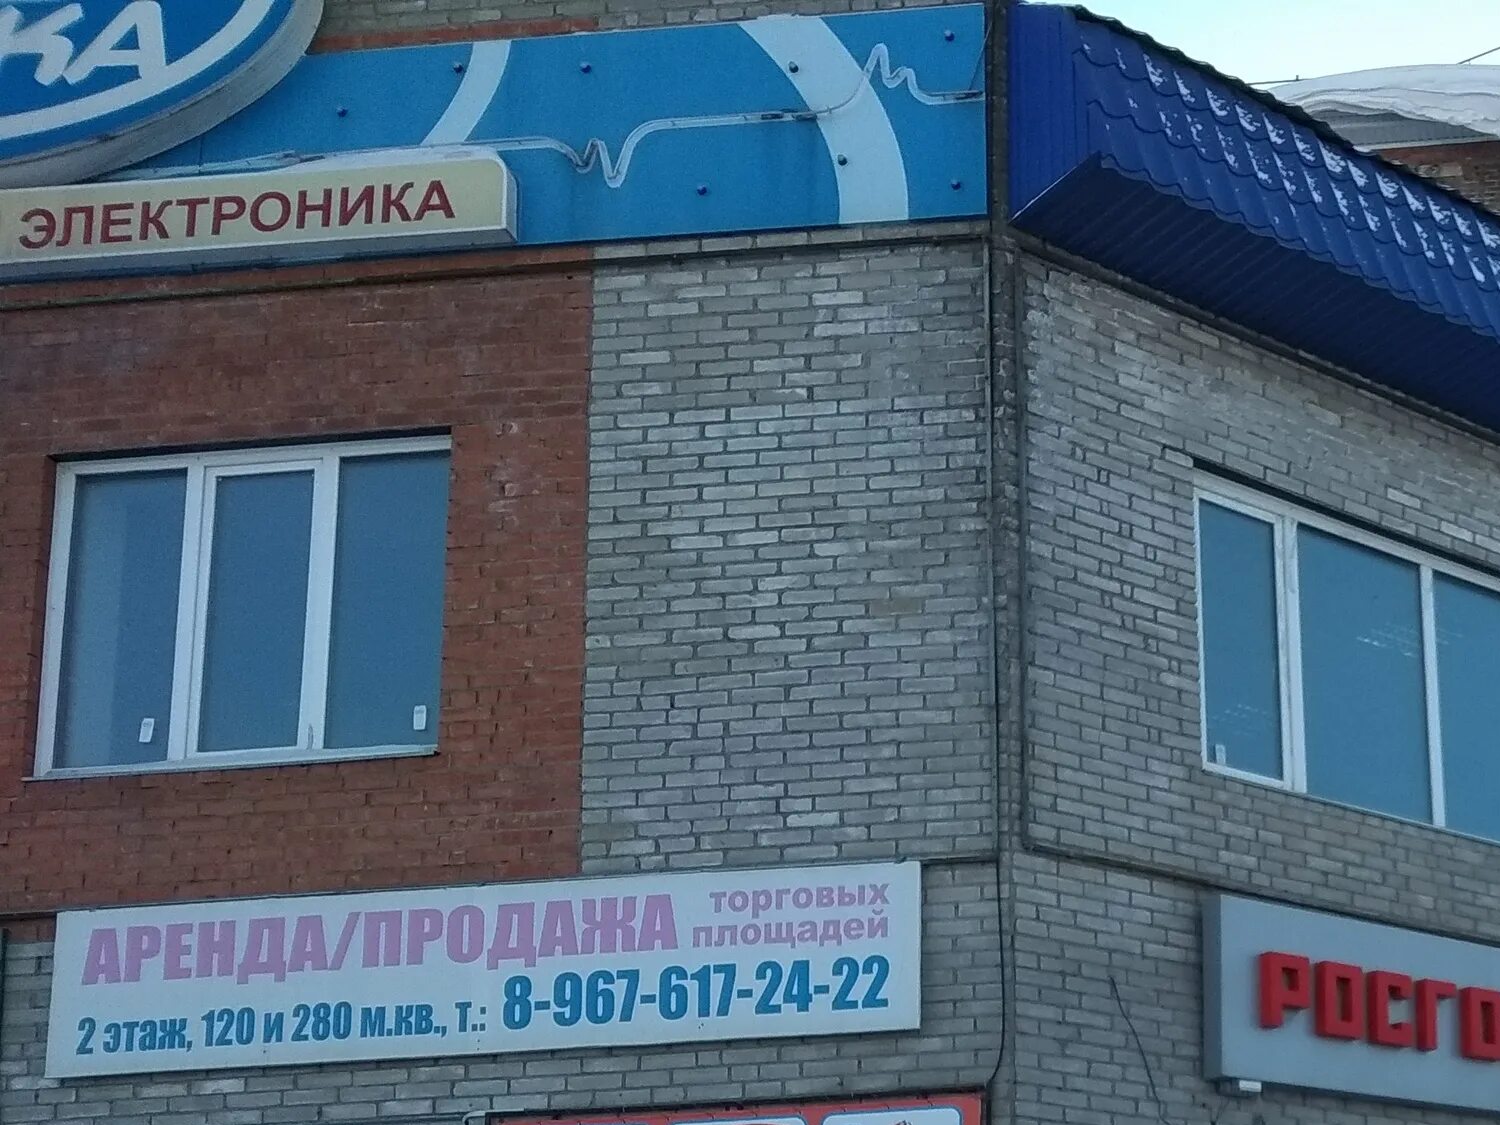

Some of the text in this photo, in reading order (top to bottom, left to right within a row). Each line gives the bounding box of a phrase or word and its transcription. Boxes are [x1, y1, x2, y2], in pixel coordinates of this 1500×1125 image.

[19, 180, 456, 250] ЭЛЕКТРОНИКА
[692, 908, 890, 948] площадей
[709, 882, 890, 918] торговых
[82, 894, 679, 987] АРЕНДА/ПРОДАЖА
[76, 1017, 96, 1055] 2
[102, 1017, 193, 1053] этаж,
[201, 1007, 255, 1047] 120
[263, 1011, 284, 1044] и
[291, 1001, 352, 1042] 280
[503, 955, 890, 1030] 8-967-617-24-22
